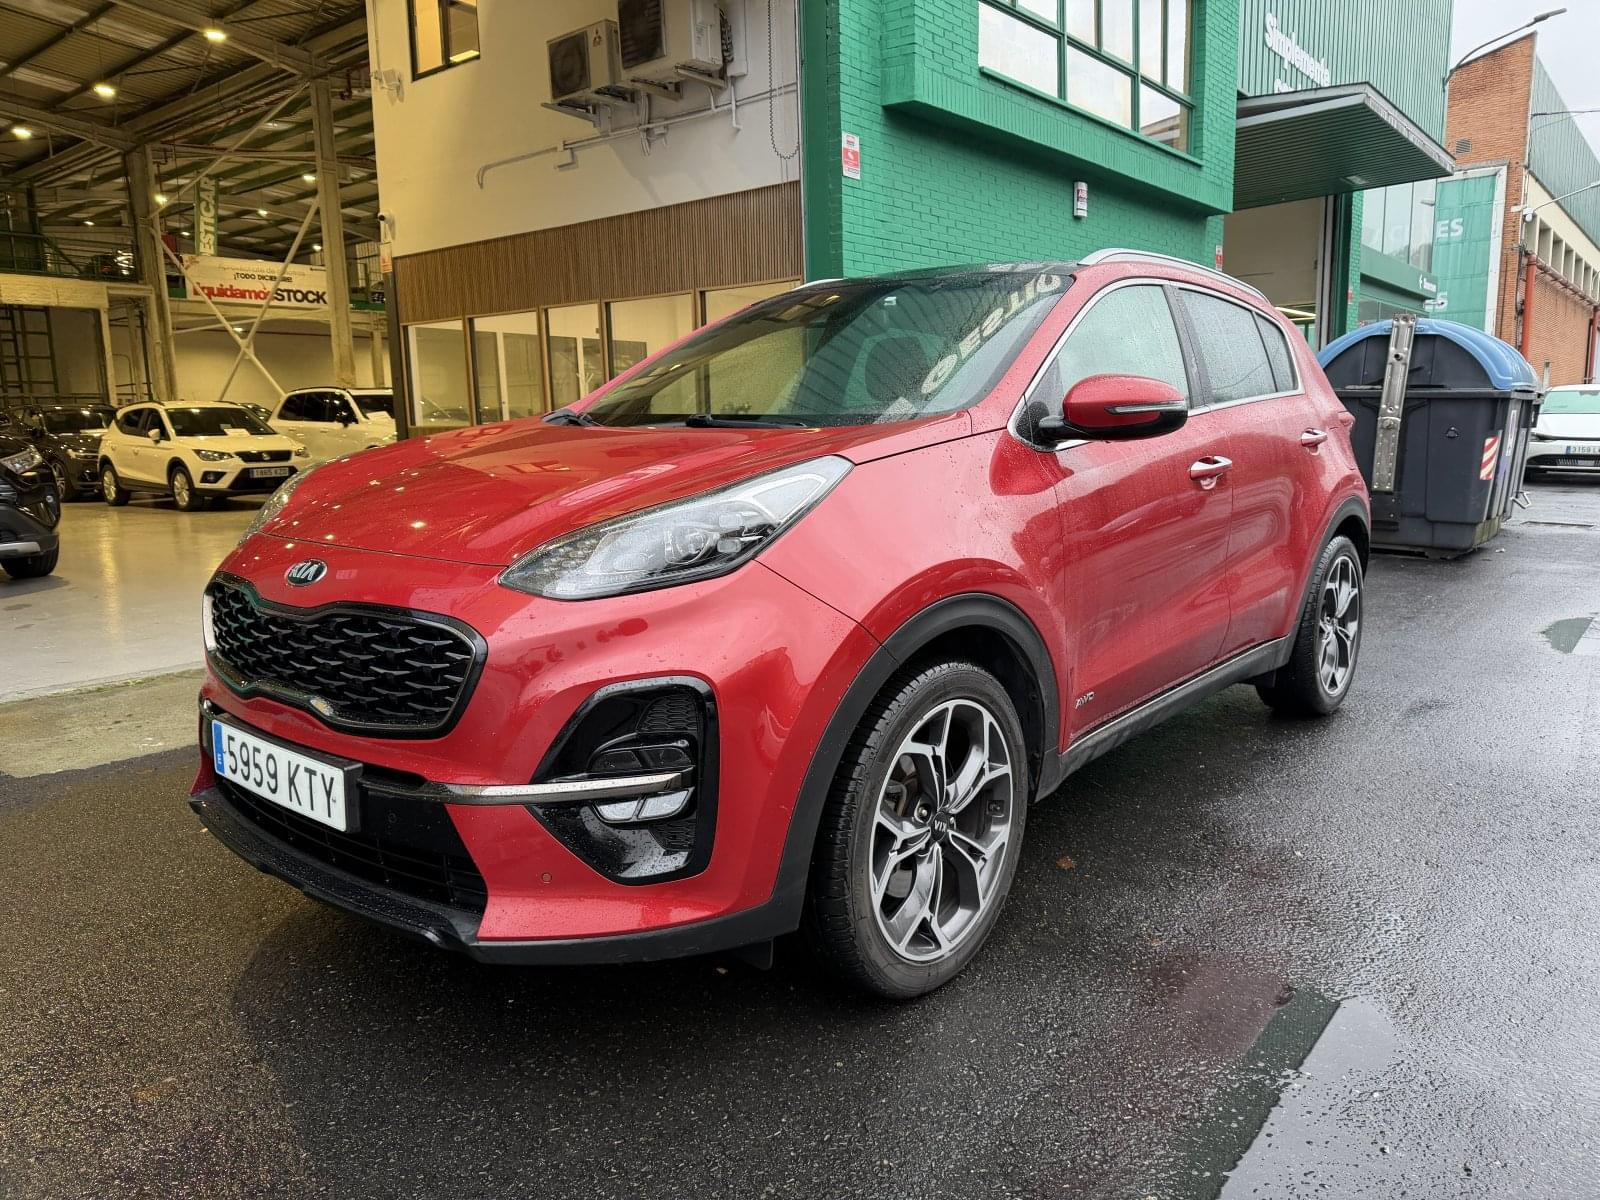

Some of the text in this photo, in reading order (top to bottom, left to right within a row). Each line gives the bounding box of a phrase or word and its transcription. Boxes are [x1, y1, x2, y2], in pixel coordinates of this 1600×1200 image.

[1264, 12, 1330, 87] Simplemente
[199, 177, 216, 256] ESTICAR
[288, 561, 319, 581] KIA
[1074, 691, 1095, 710] AWD
[227, 735, 335, 819] 5959 KTY
